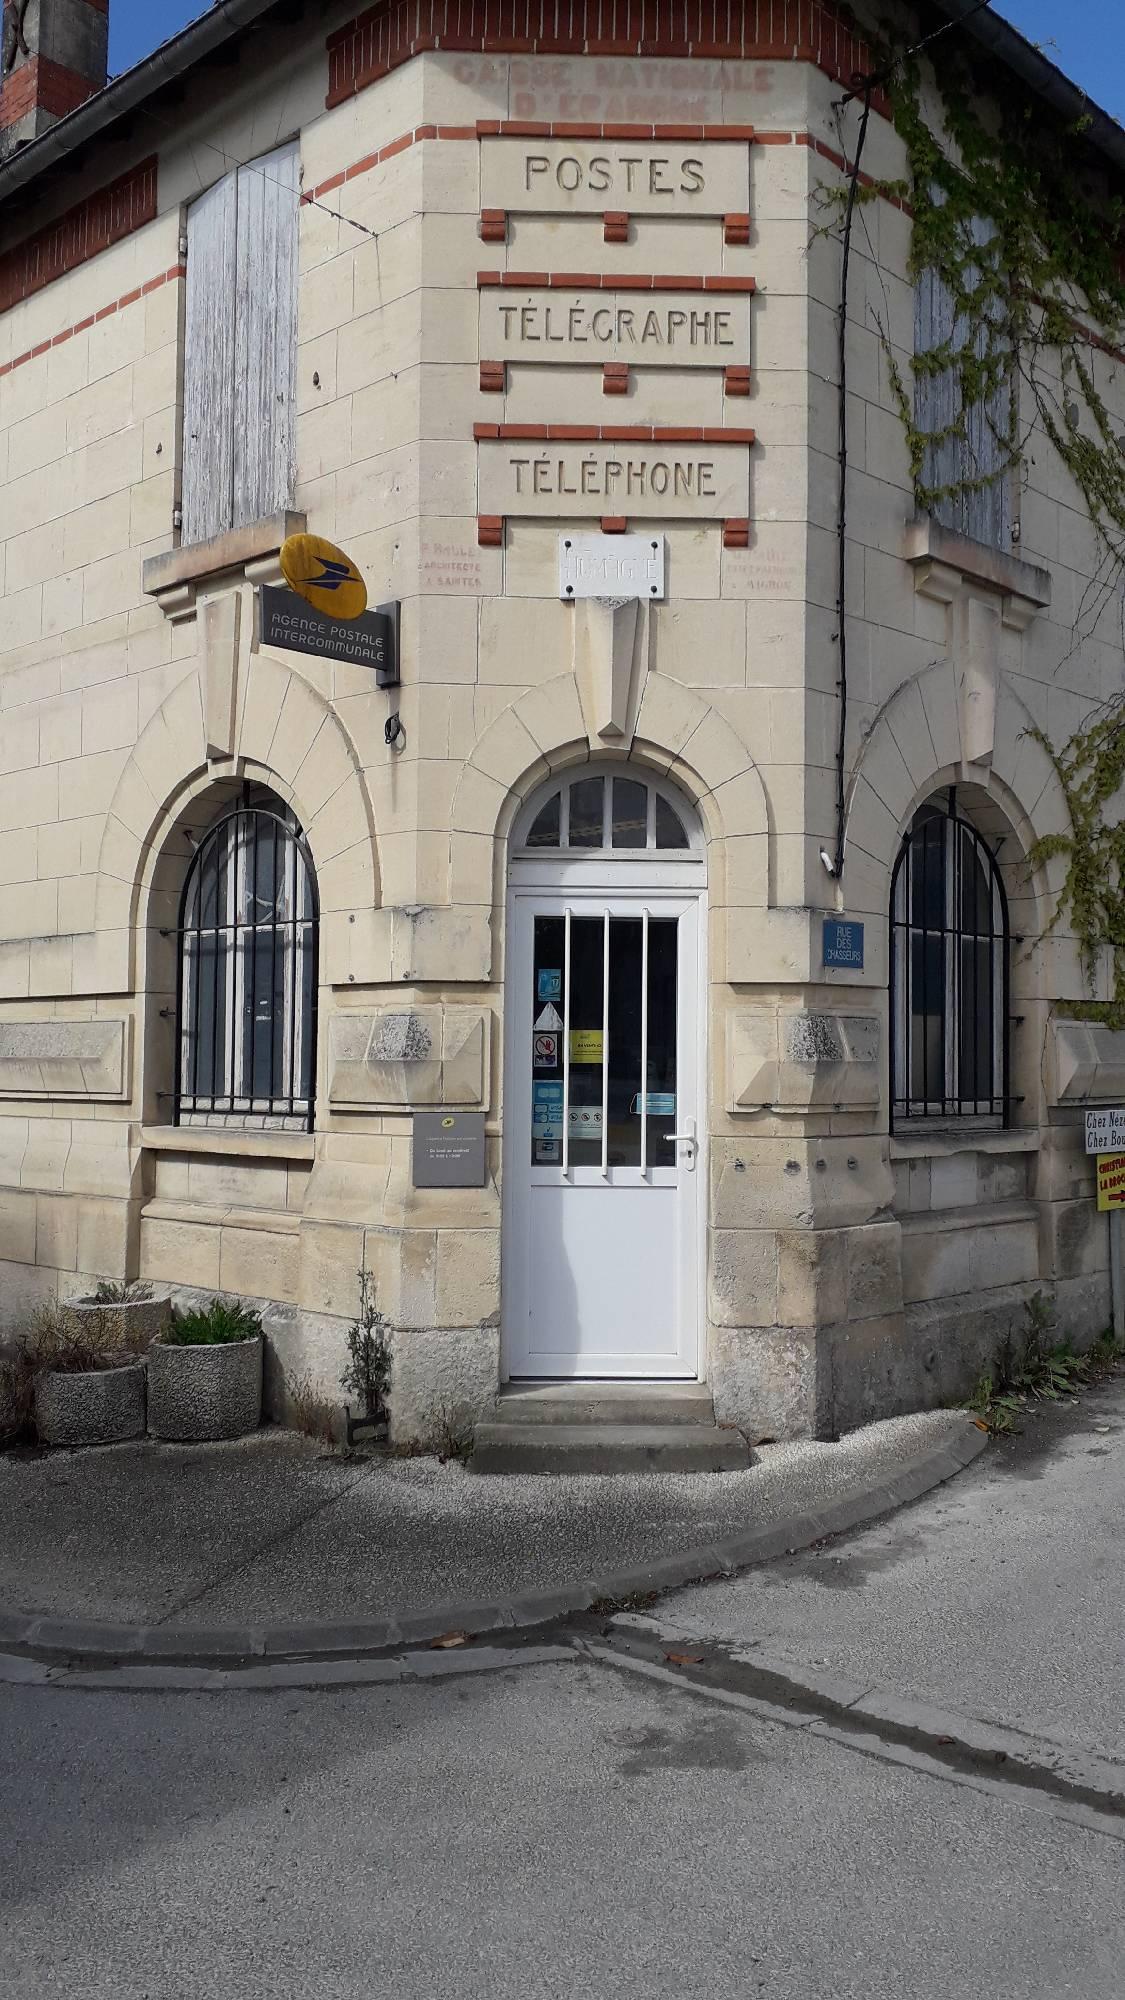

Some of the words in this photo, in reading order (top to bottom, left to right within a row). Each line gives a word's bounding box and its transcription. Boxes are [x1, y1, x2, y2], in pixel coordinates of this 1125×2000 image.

[525, 155, 706, 194] POSTES
[499, 298, 734, 346] TÉLÉGRAPHE
[509, 452, 717, 496] TÉLÉPHONE
[271, 613, 326, 633] AGENCE
[330, 626, 384, 648] POSTALE
[271, 627, 384, 661] INTERCOMMUNALE
[836, 926, 852, 938] RUE
[836, 938, 852, 949] DES
[827, 949, 862, 961] CHASSEURS
[1087, 1112, 1106, 1128] Chez
[1088, 1131, 1107, 1148] Chez
